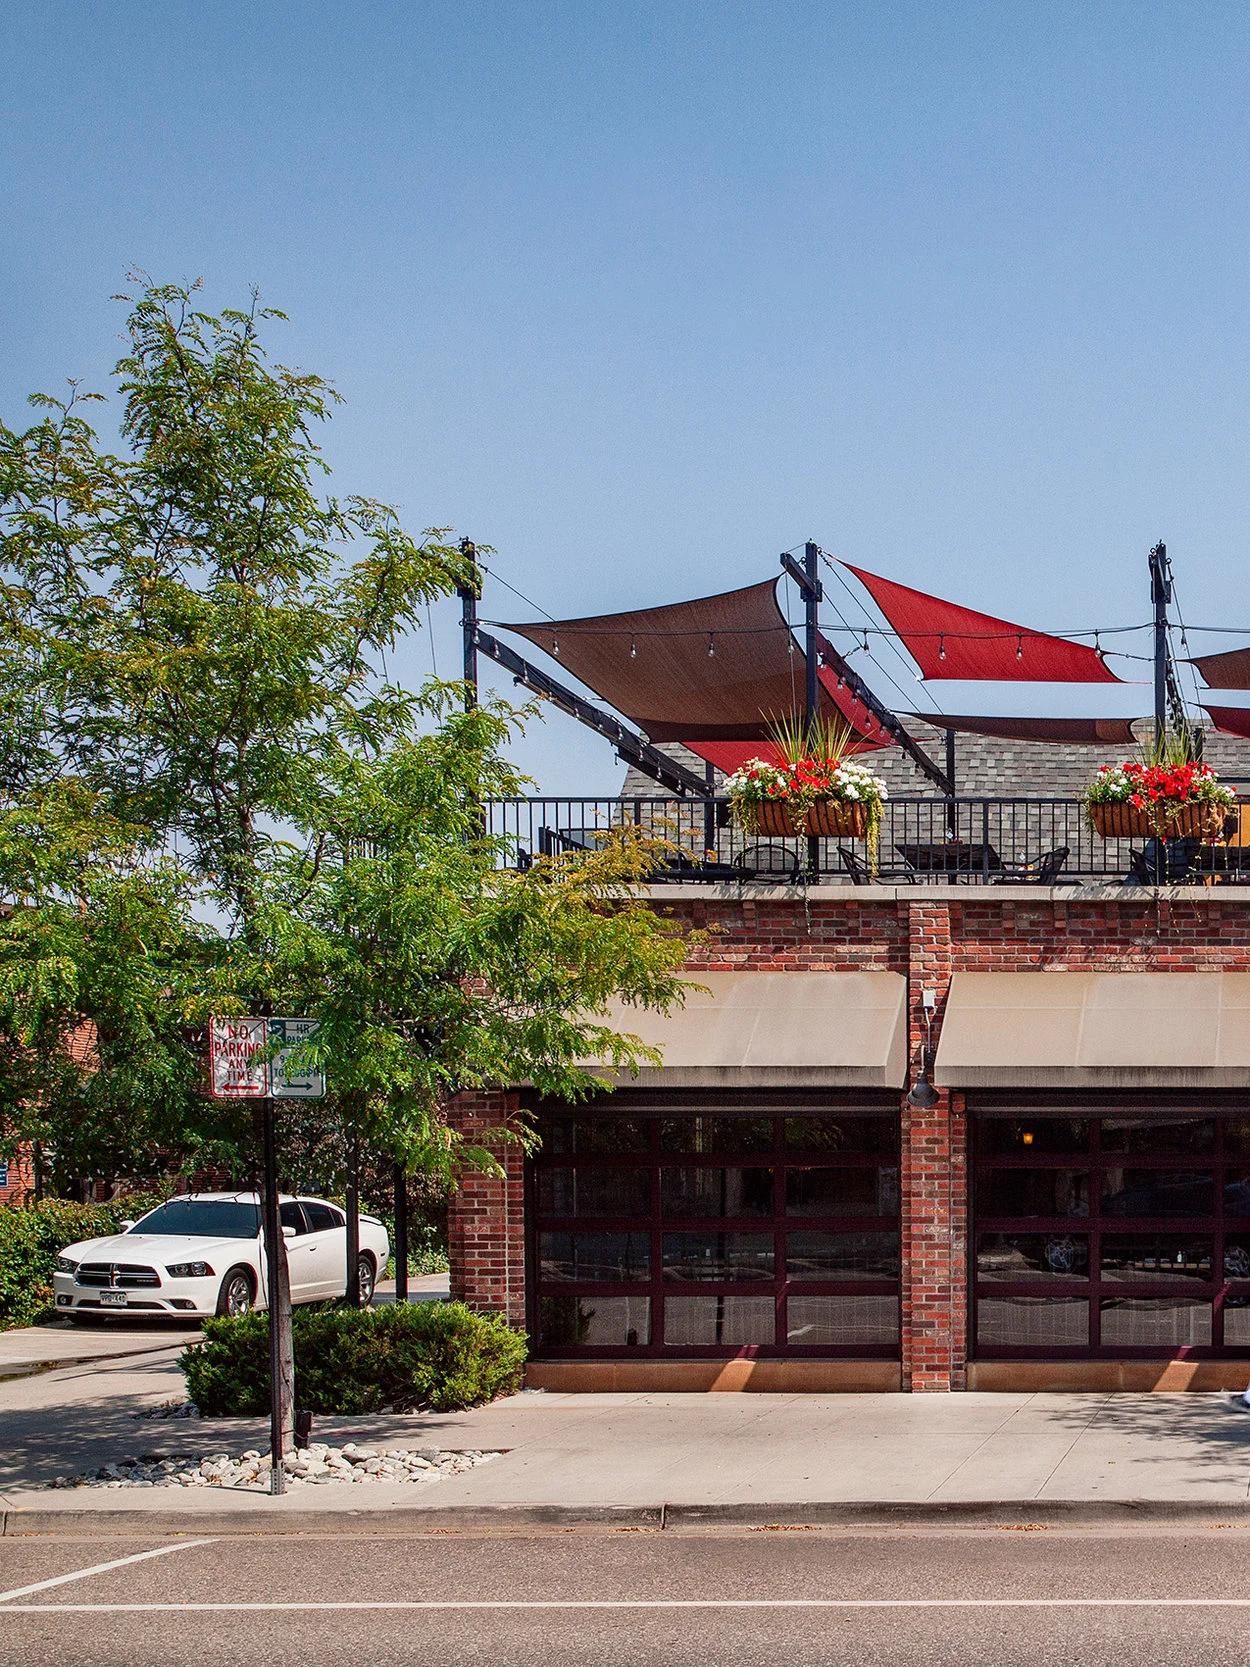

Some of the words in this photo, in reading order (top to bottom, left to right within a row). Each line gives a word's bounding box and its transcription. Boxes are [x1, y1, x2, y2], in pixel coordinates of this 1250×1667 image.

[228, 1025, 248, 1039] NO
[229, 1059, 251, 1068] ANY
[227, 1071, 253, 1080] TIME
